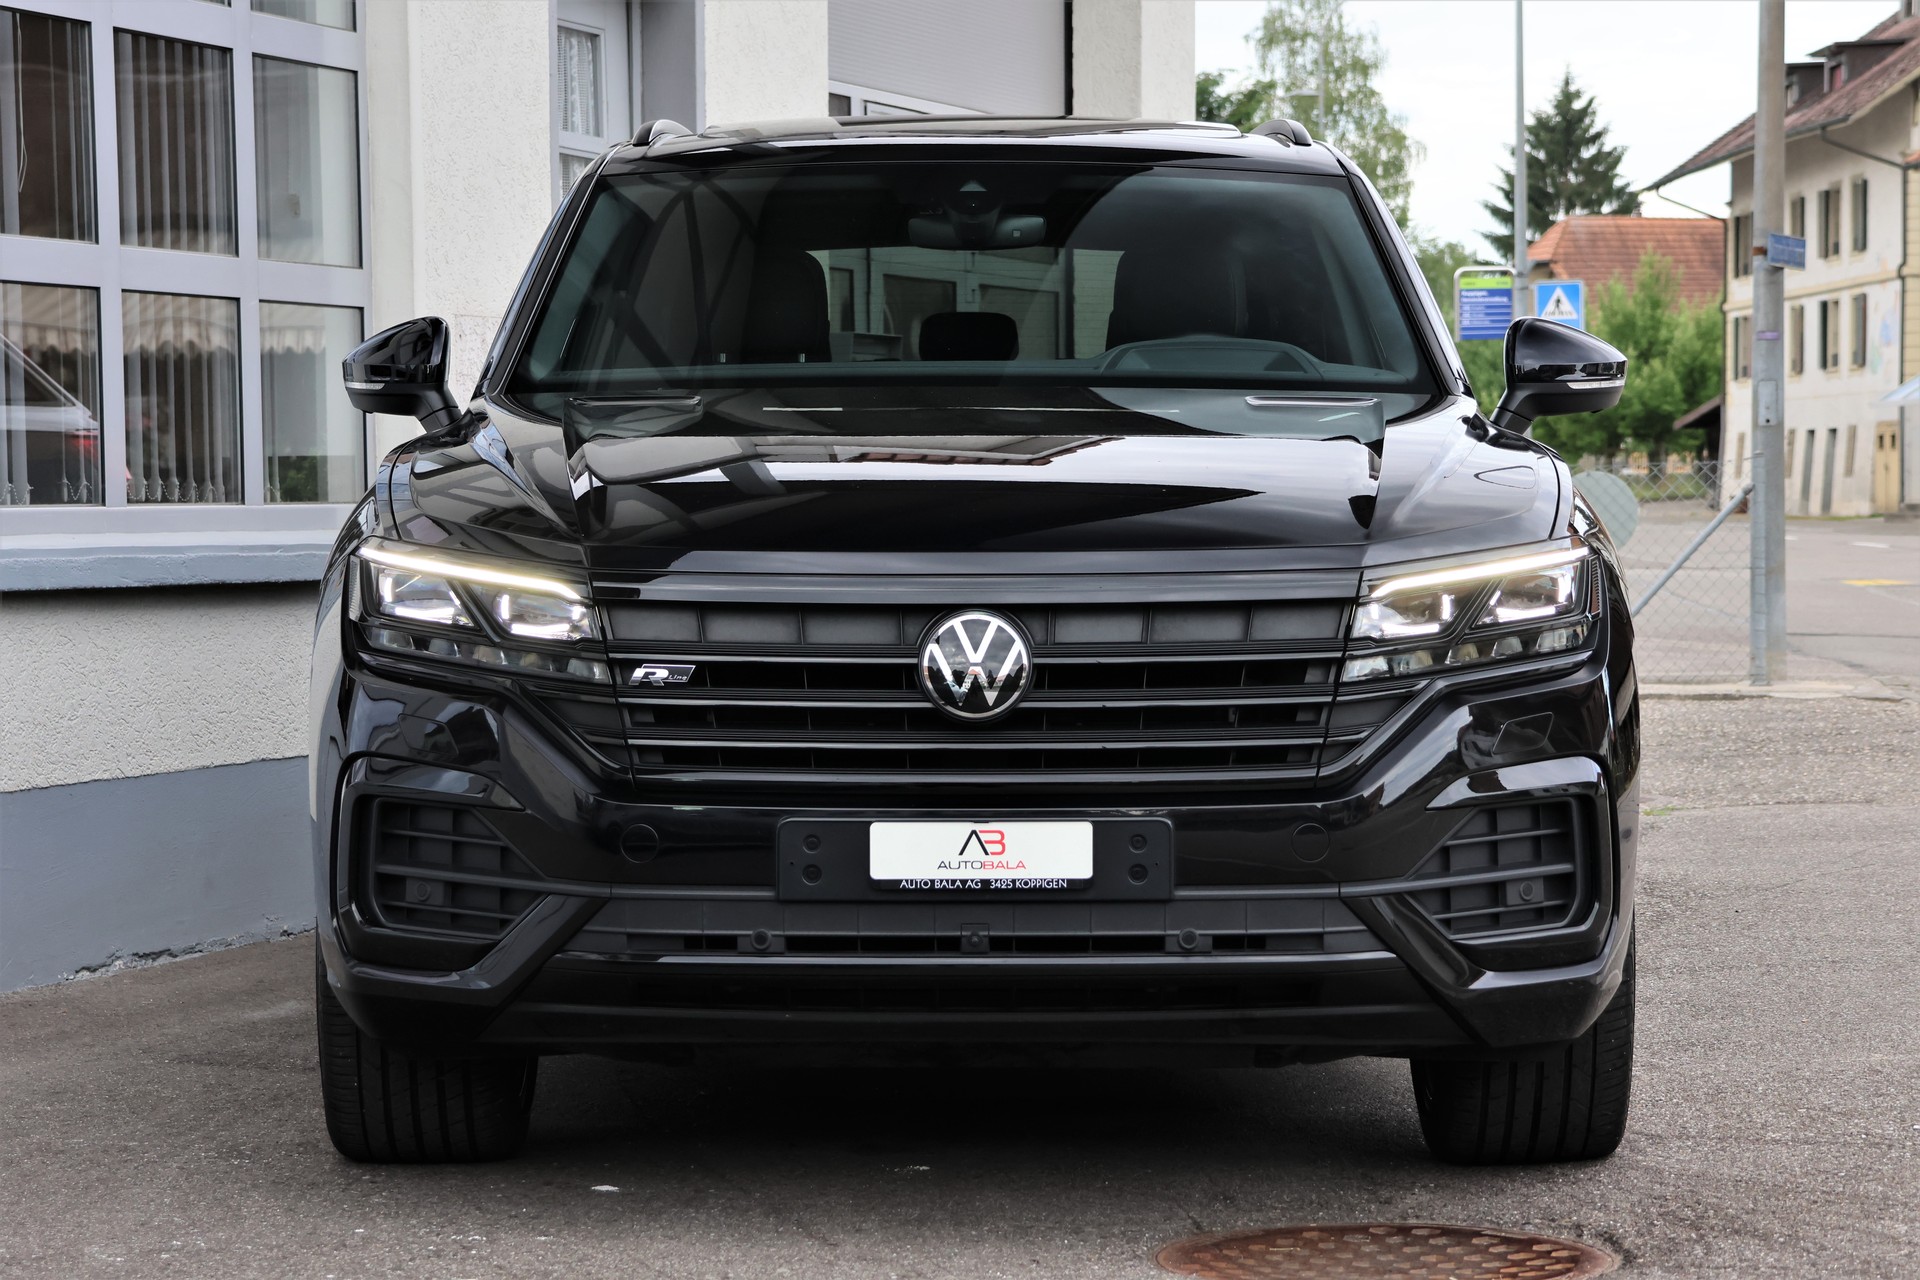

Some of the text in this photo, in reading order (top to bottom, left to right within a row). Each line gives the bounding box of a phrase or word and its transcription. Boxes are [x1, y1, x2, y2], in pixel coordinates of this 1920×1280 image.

[924, 614, 1027, 714] VW
[937, 860, 1026, 870] AUTOBALA
[900, 879, 1067, 889] AUTO BALA AG 3425 KOPPIGEN
